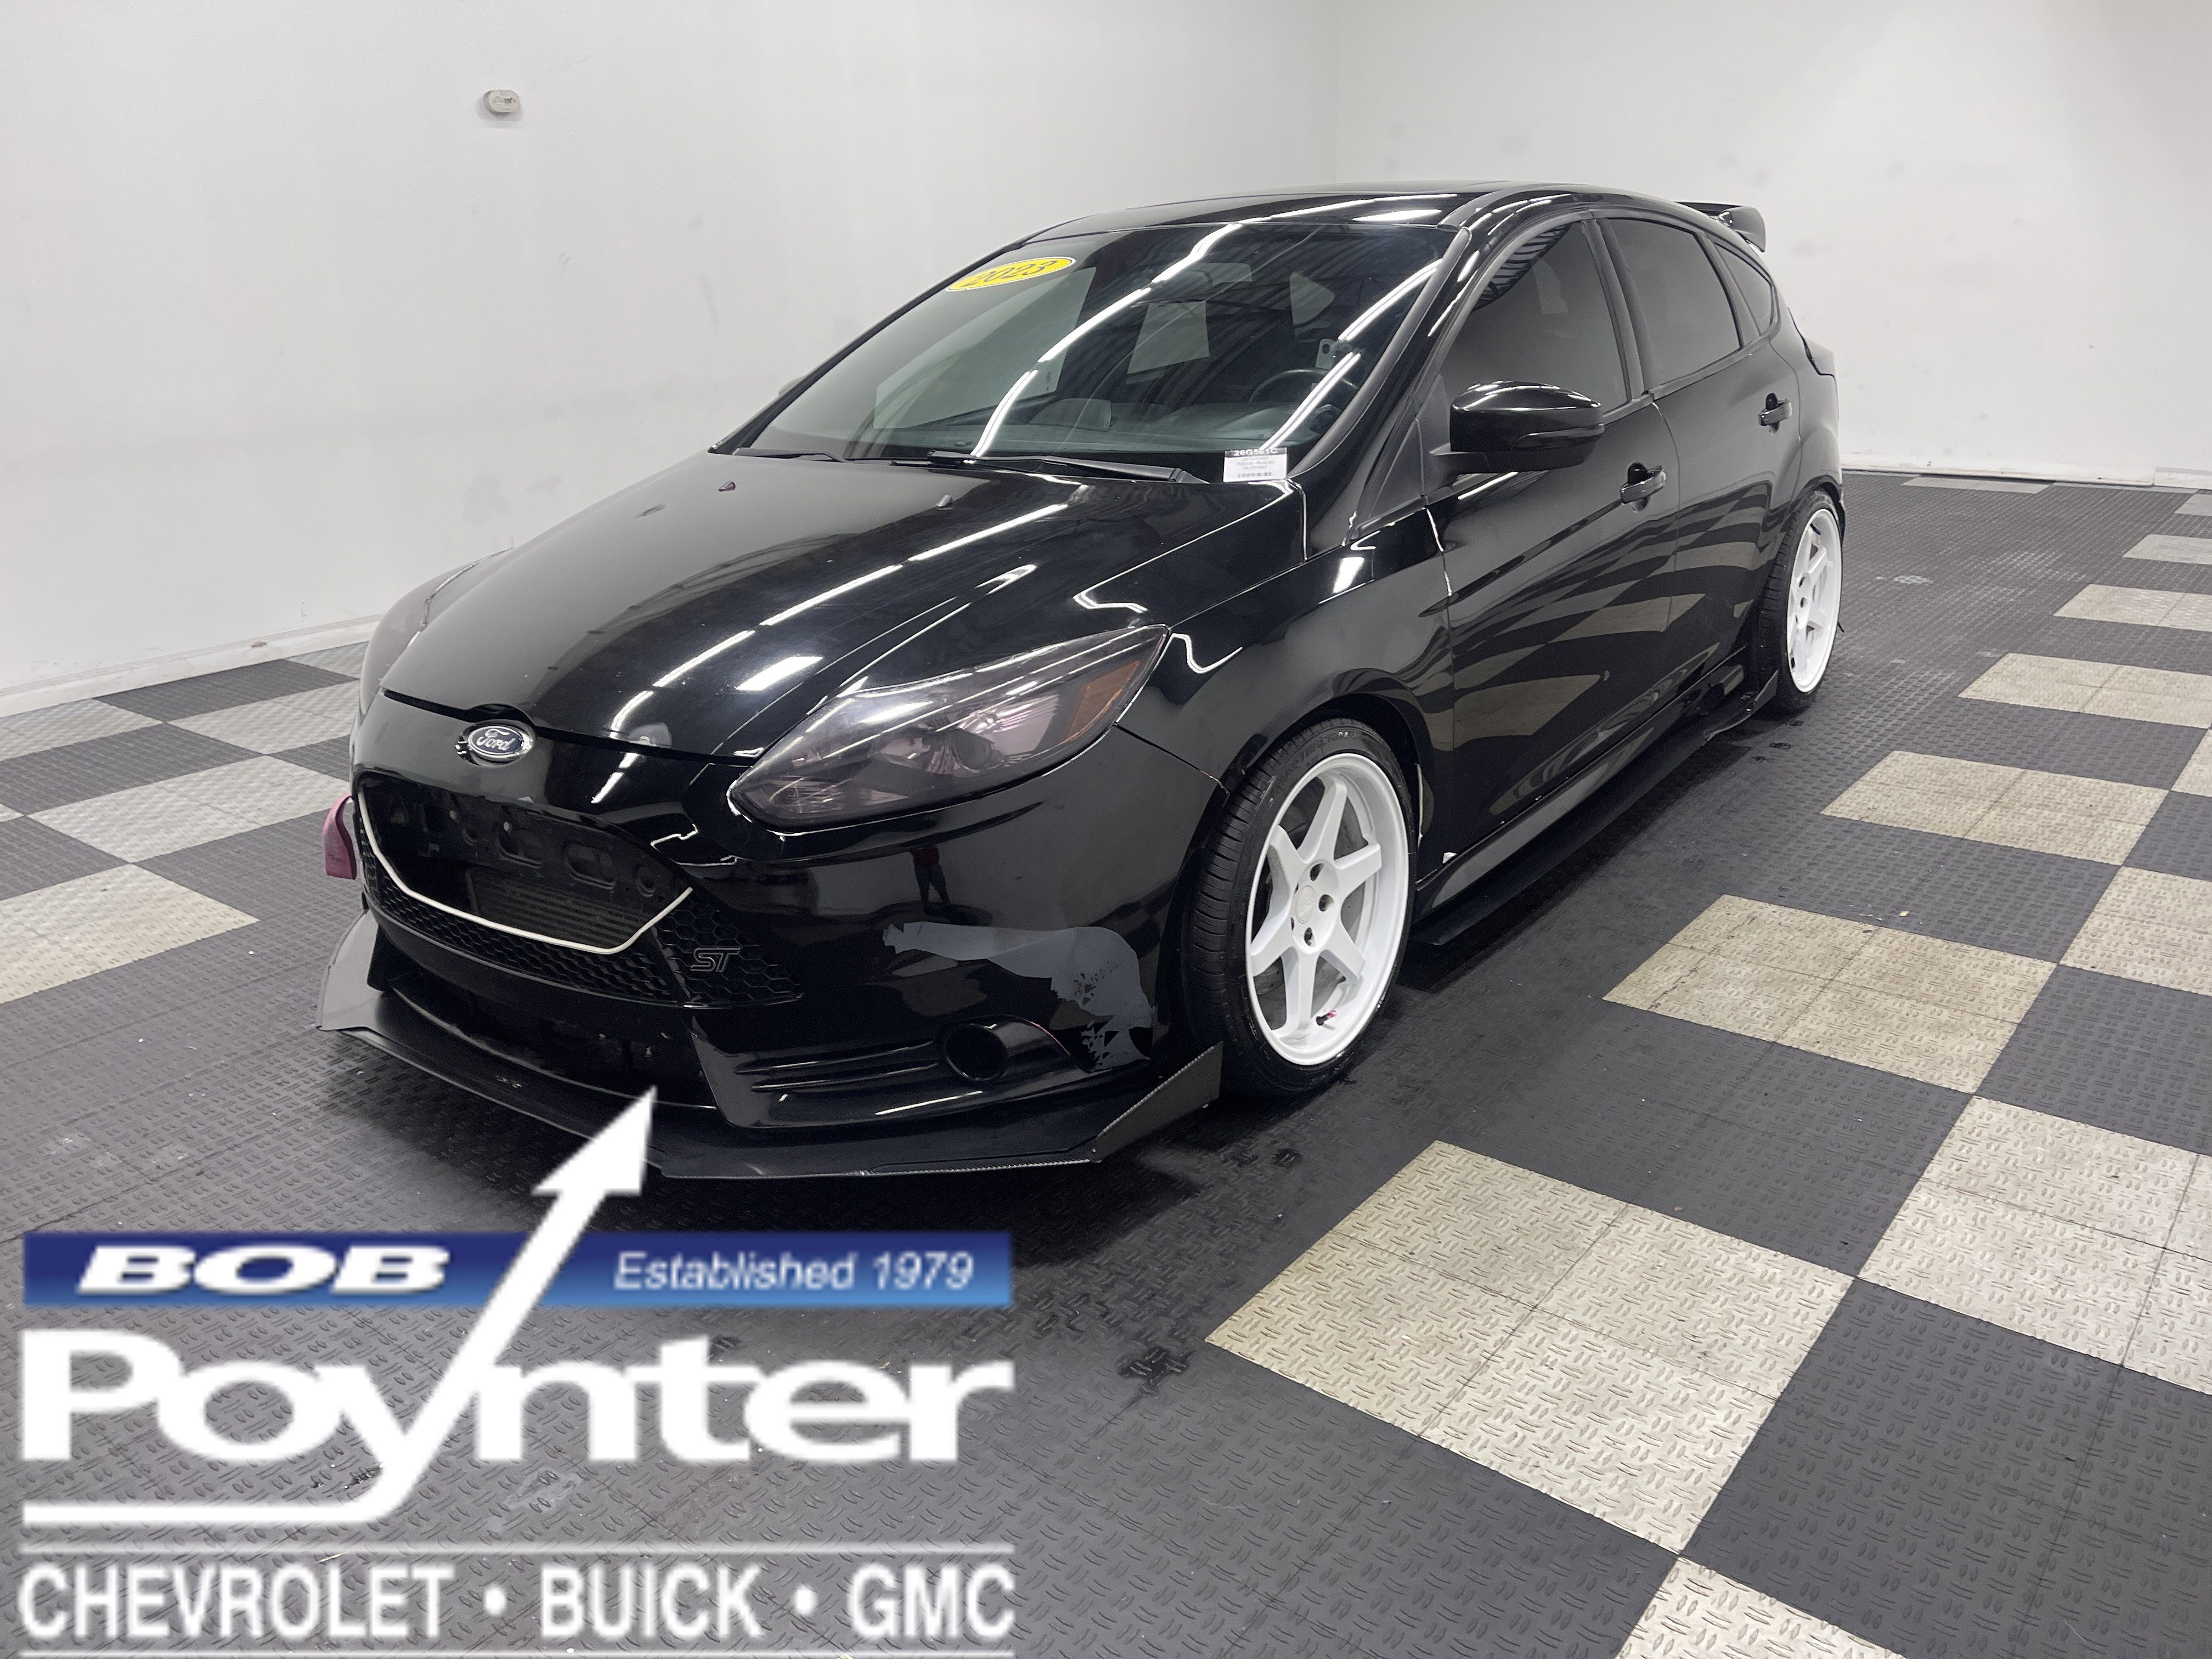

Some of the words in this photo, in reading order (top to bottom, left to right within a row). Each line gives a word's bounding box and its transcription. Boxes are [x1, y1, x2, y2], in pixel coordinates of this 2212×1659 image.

[959, 259, 1058, 288] 2023
[1234, 448, 1278, 456] 26G561C
[476, 728, 516, 751] Ford
[690, 947, 741, 973] ST
